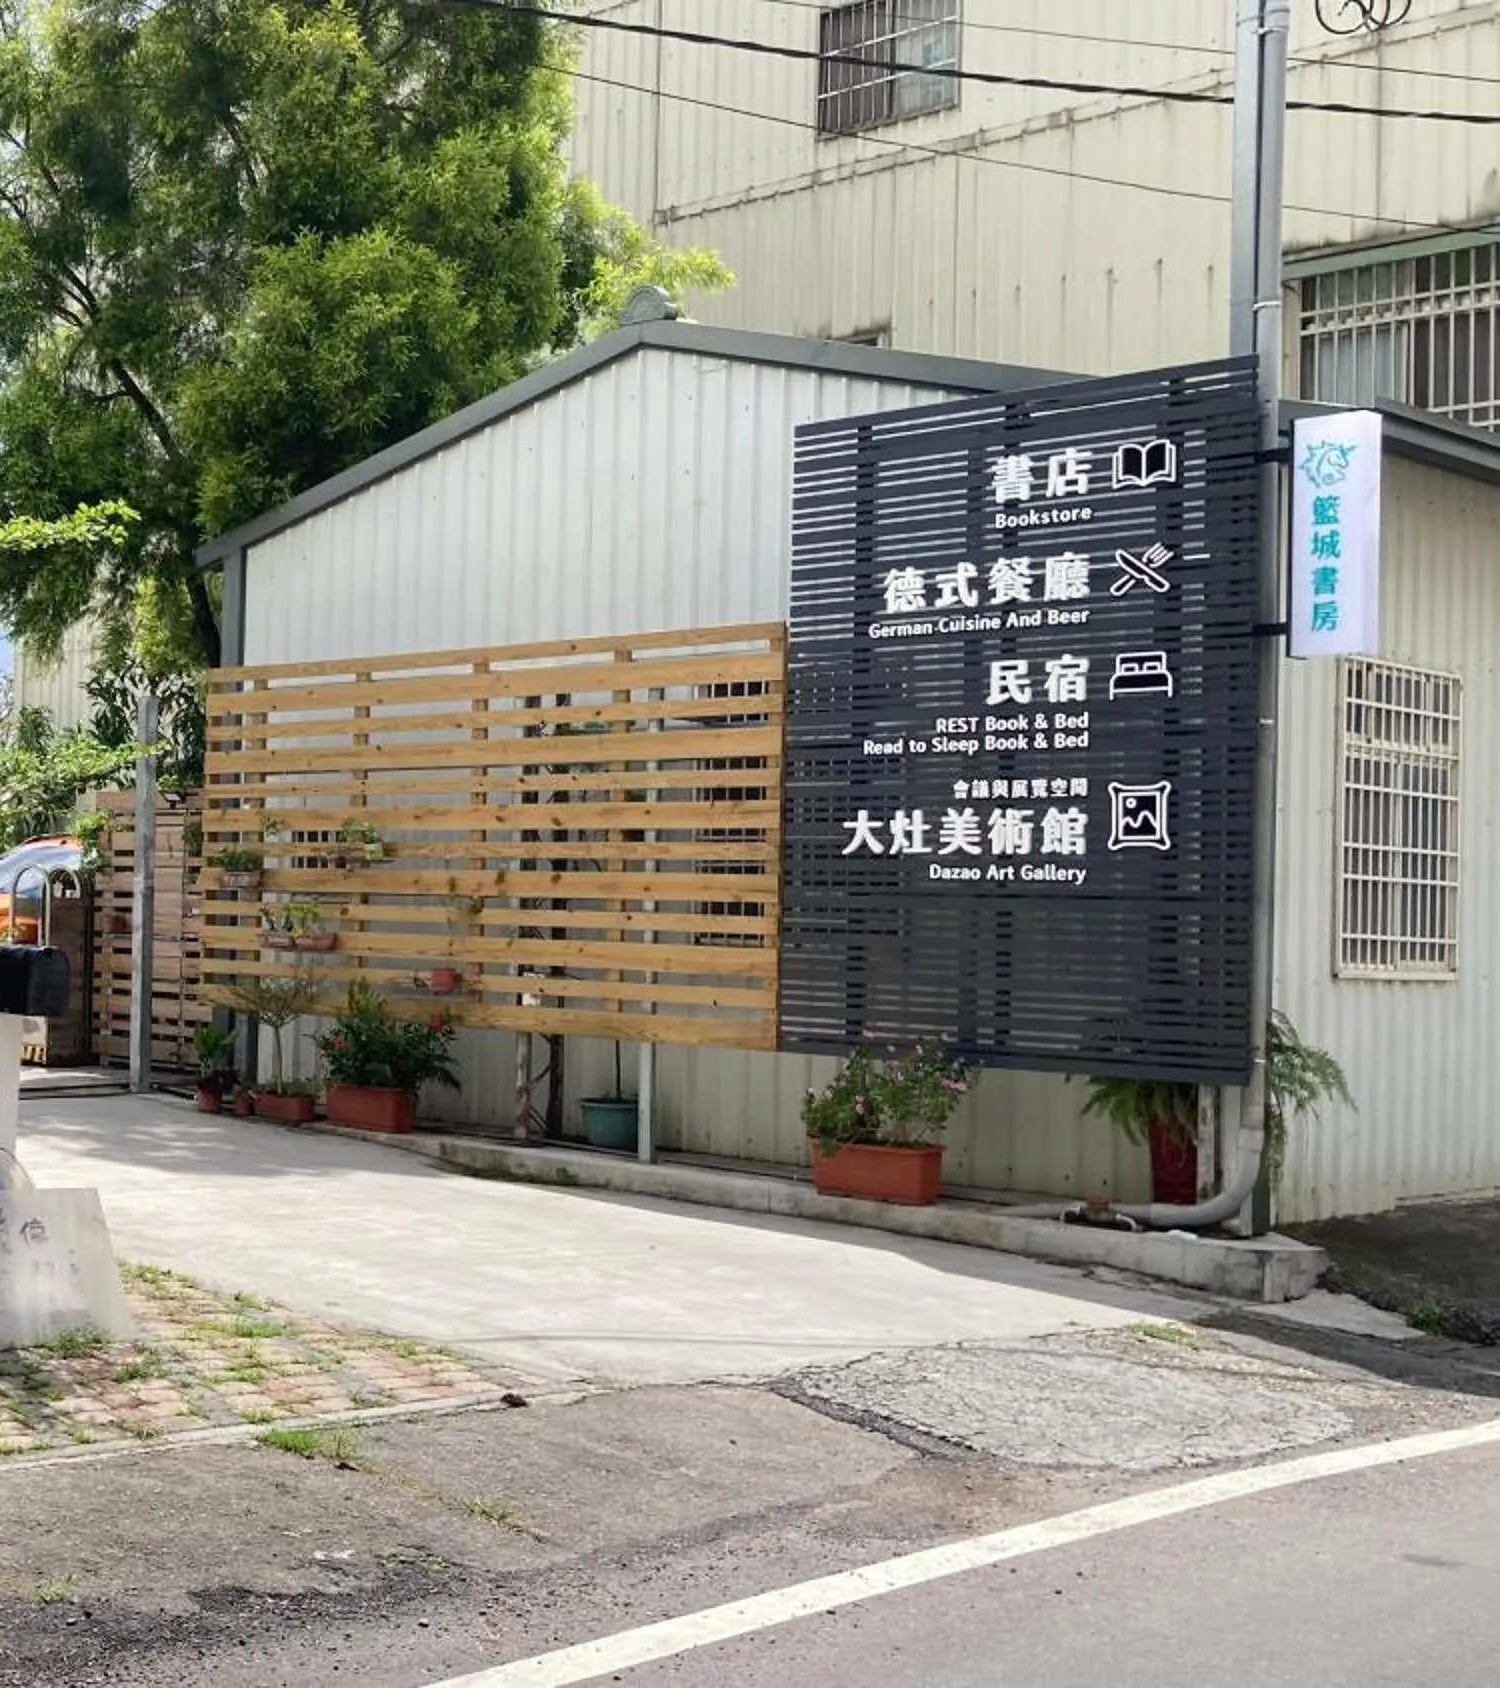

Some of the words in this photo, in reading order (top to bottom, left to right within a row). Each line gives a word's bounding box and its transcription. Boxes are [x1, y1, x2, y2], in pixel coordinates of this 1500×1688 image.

[990, 447, 1093, 503] 書店
[995, 507, 1093, 529] Bookstore
[883, 551, 1091, 614] 德式餐廳
[1310, 495, 1341, 632] 籃城書房
[868, 621, 933, 639] German
[938, 613, 1001, 633] Cuisine
[1006, 609, 1042, 628] And
[1048, 608, 1090, 625] Beer
[985, 653, 1090, 705] 民宿
[936, 716, 980, 734] REST
[985, 715, 1029, 732] Book
[1033, 713, 1049, 730] &
[1054, 711, 1089, 729] Bed
[863, 738, 903, 756] Read
[909, 739, 927, 753] to
[931, 735, 979, 756] Sleep
[985, 734, 1029, 750] Book
[1033, 733, 1049, 749] &
[1054, 732, 1089, 749] Bed
[841, 806, 1089, 856] 大灶美術館
[929, 864, 981, 880] Dazao
[986, 864, 1016, 880] Art
[1021, 863, 1087, 885] Gallery
